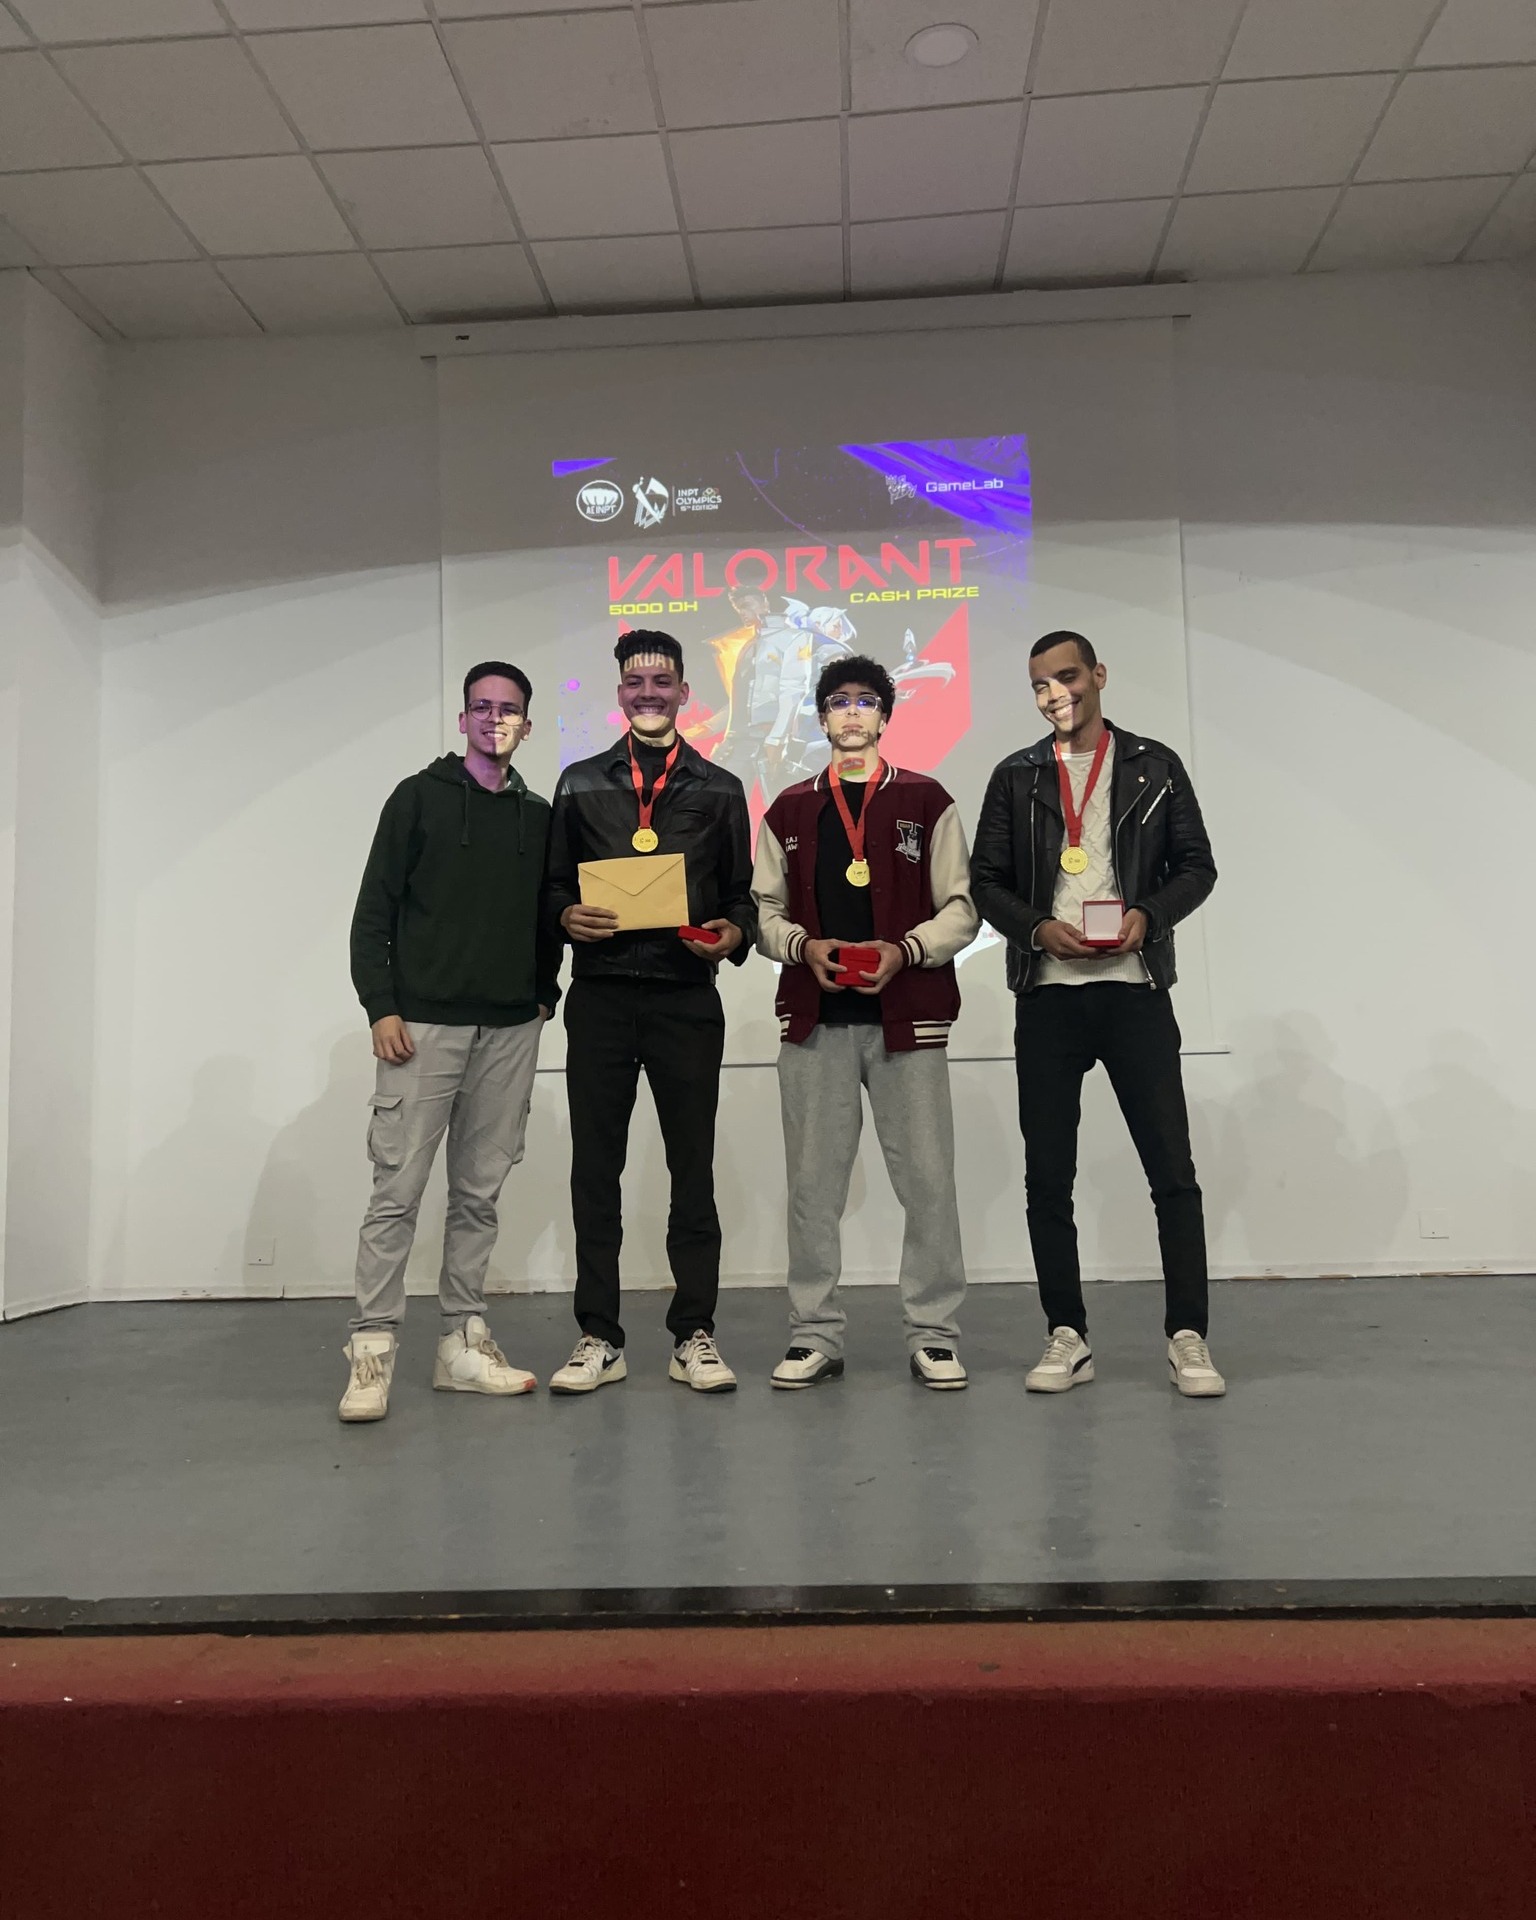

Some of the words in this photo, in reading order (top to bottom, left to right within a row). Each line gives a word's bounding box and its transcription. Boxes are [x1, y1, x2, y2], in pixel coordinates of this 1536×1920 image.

[677, 488, 699, 497] INPT
[925, 478, 1004, 493] GameLab
[675, 494, 722, 506] OLYMPICS
[608, 538, 977, 602] VALORANT
[850, 589, 910, 603] CASH
[916, 586, 979, 600] PRIZE
[609, 602, 663, 615] 5000
[668, 601, 698, 613] DH
